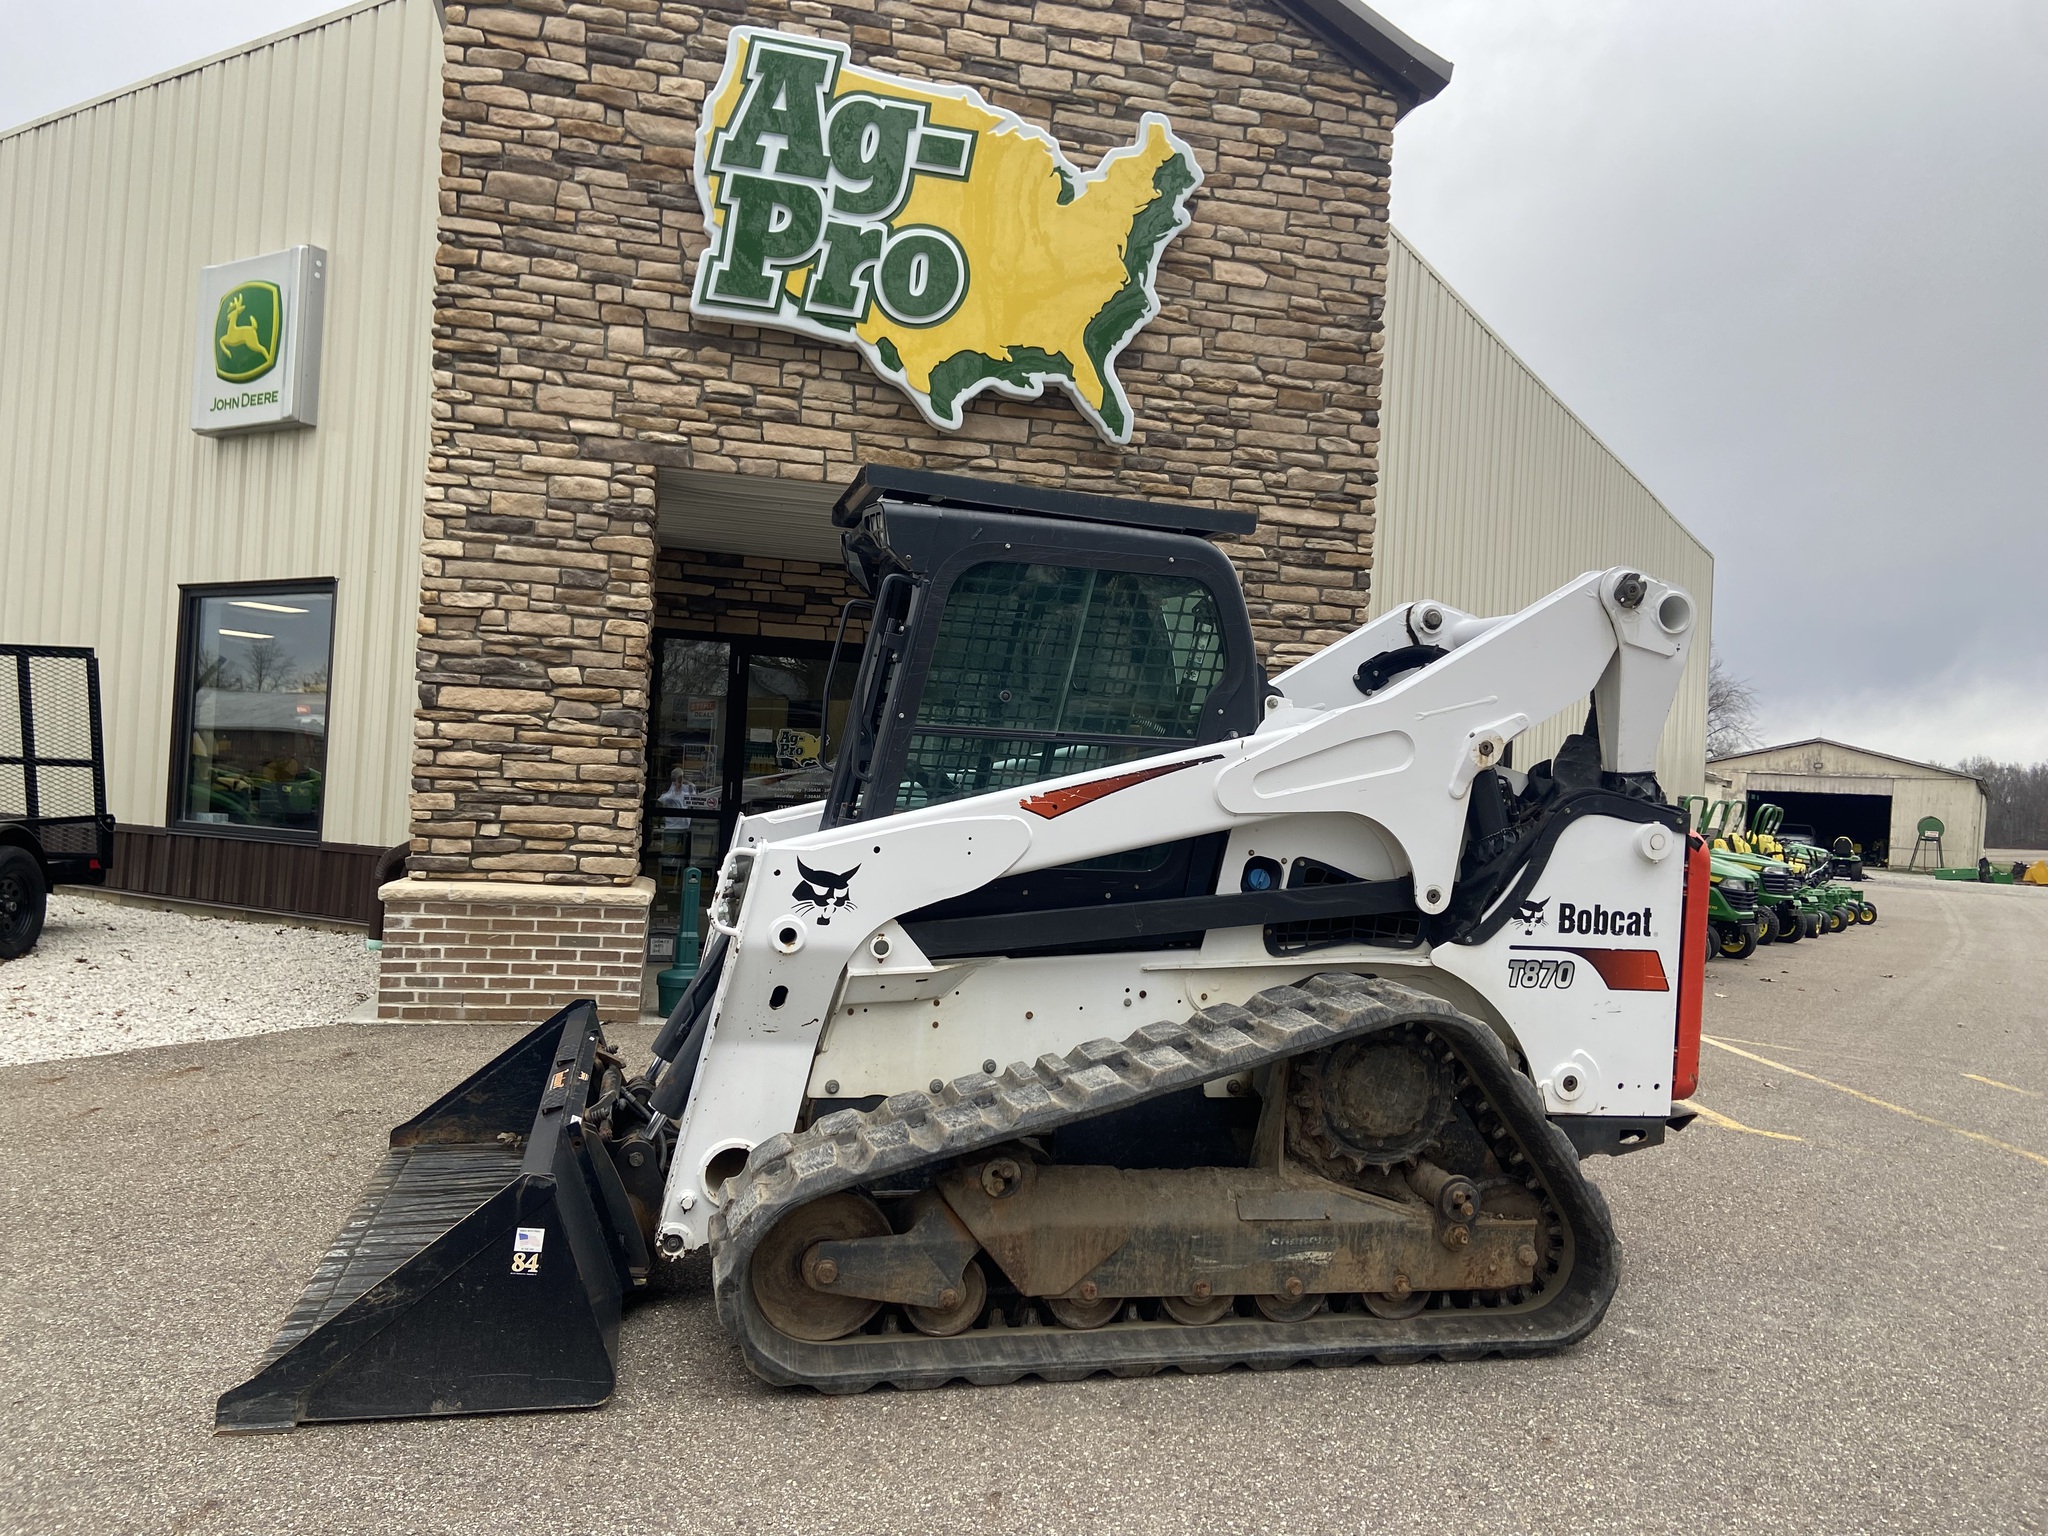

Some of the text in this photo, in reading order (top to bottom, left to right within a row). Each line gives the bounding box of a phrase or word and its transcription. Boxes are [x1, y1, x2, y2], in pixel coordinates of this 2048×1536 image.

[708, 38, 974, 218] Ag-
[704, 172, 967, 326] Pro
[779, 731, 804, 746] Ag-
[779, 743, 804, 756] Pro
[1558, 902, 1653, 937] Bobcat
[1507, 958, 1576, 990] T870
[511, 1252, 540, 1273] 84
